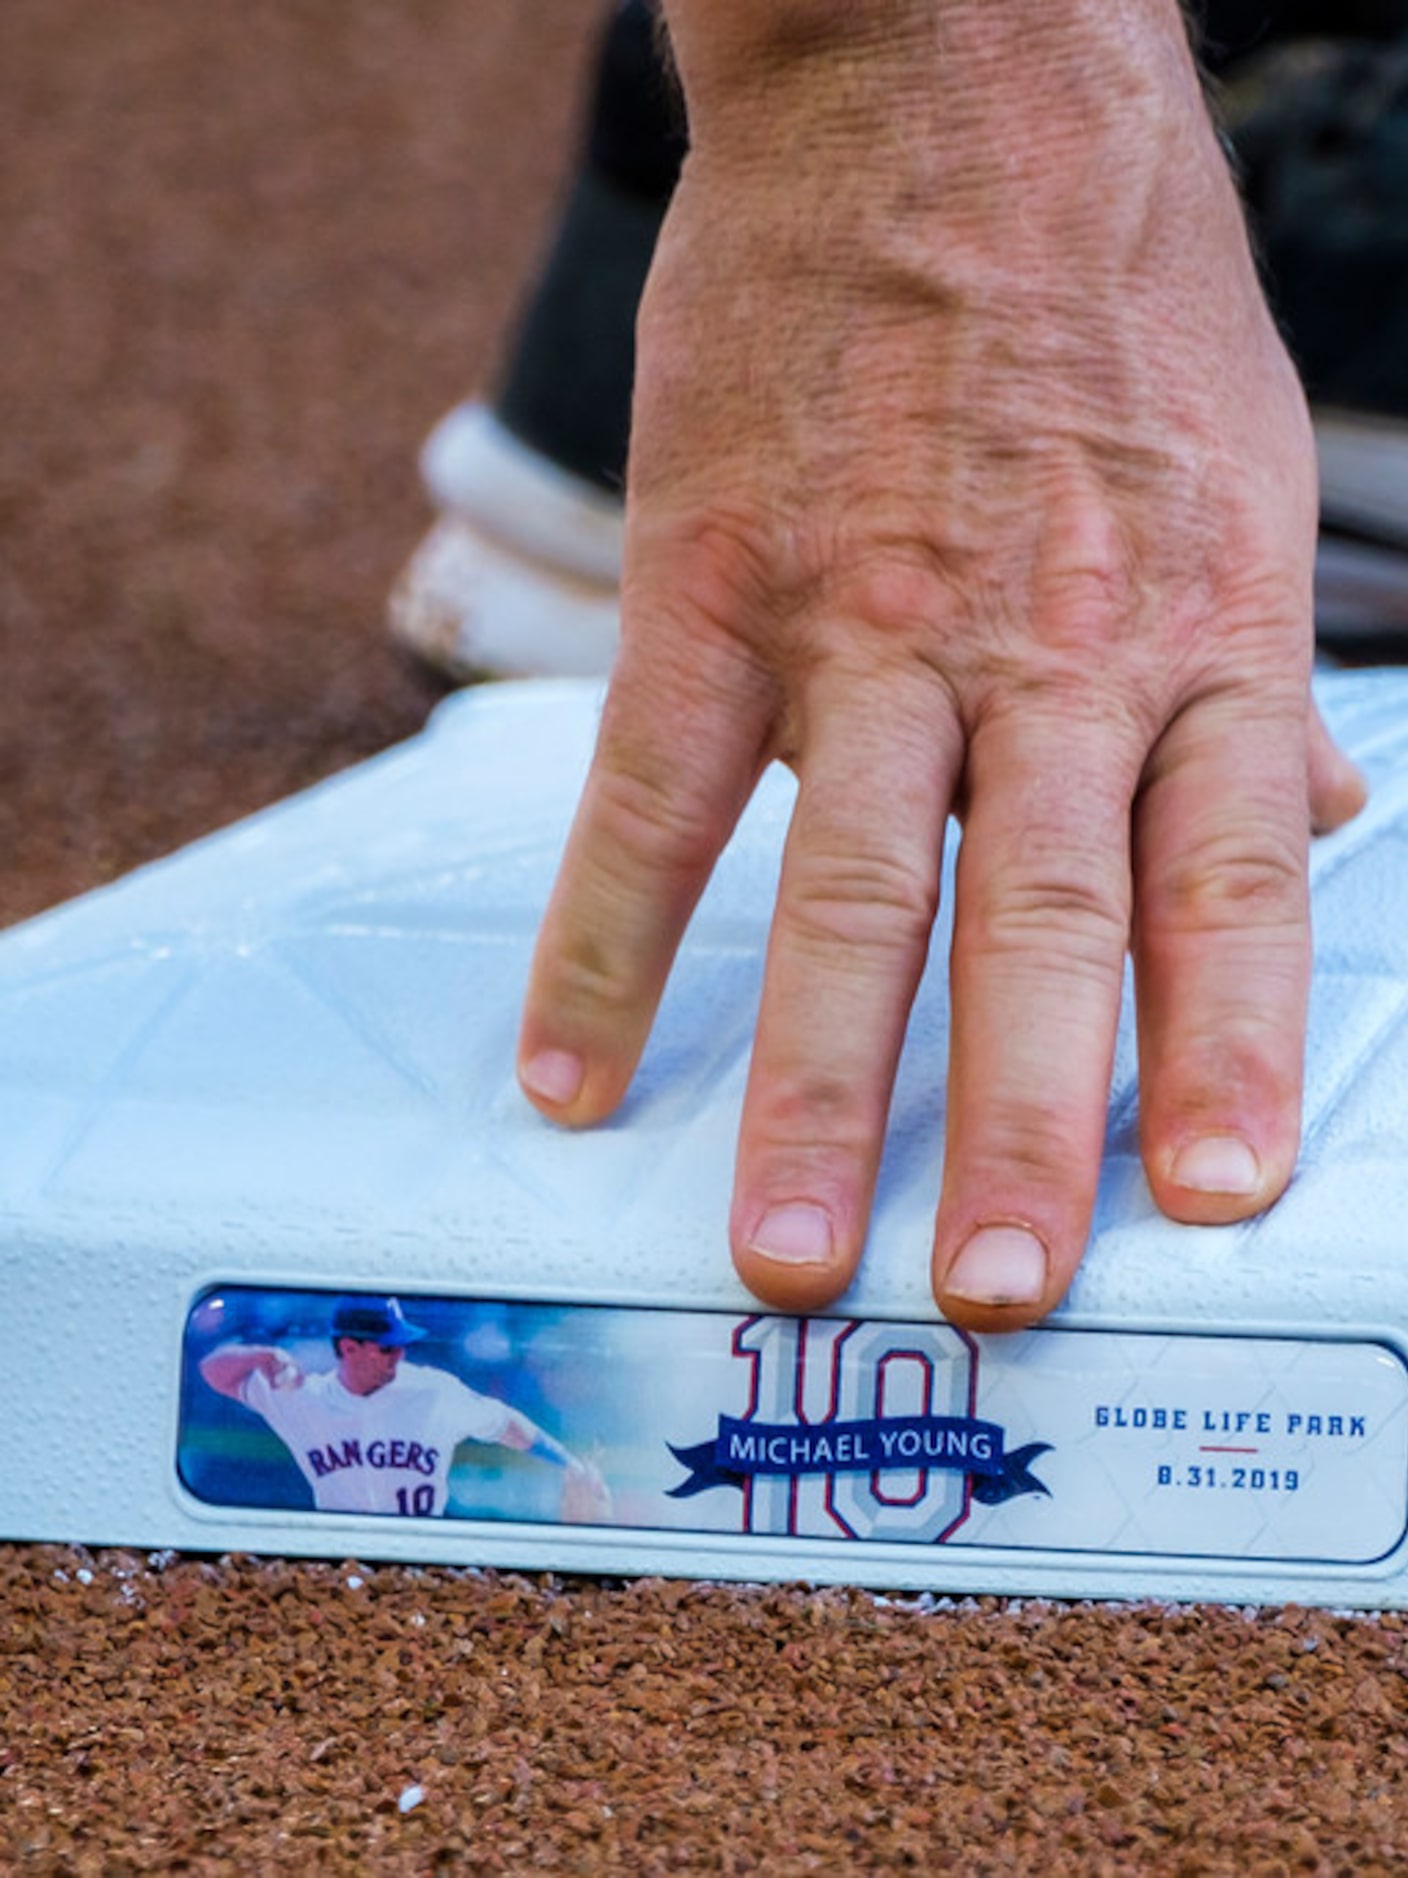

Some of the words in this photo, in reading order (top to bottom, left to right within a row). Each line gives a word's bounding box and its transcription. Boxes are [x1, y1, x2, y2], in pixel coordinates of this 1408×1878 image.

[732, 1313, 980, 1544] 10
[1094, 1406, 1188, 1430] GLOBE
[1203, 1410, 1271, 1433] LIFE
[1287, 1413, 1366, 1437] PARK
[307, 1439, 440, 1477] RANGERS
[729, 1433, 869, 1464] MICHAEL
[879, 1429, 992, 1460] YOUNG
[1157, 1465, 1300, 1491] 8.31.2019
[396, 1484, 435, 1516] 10
